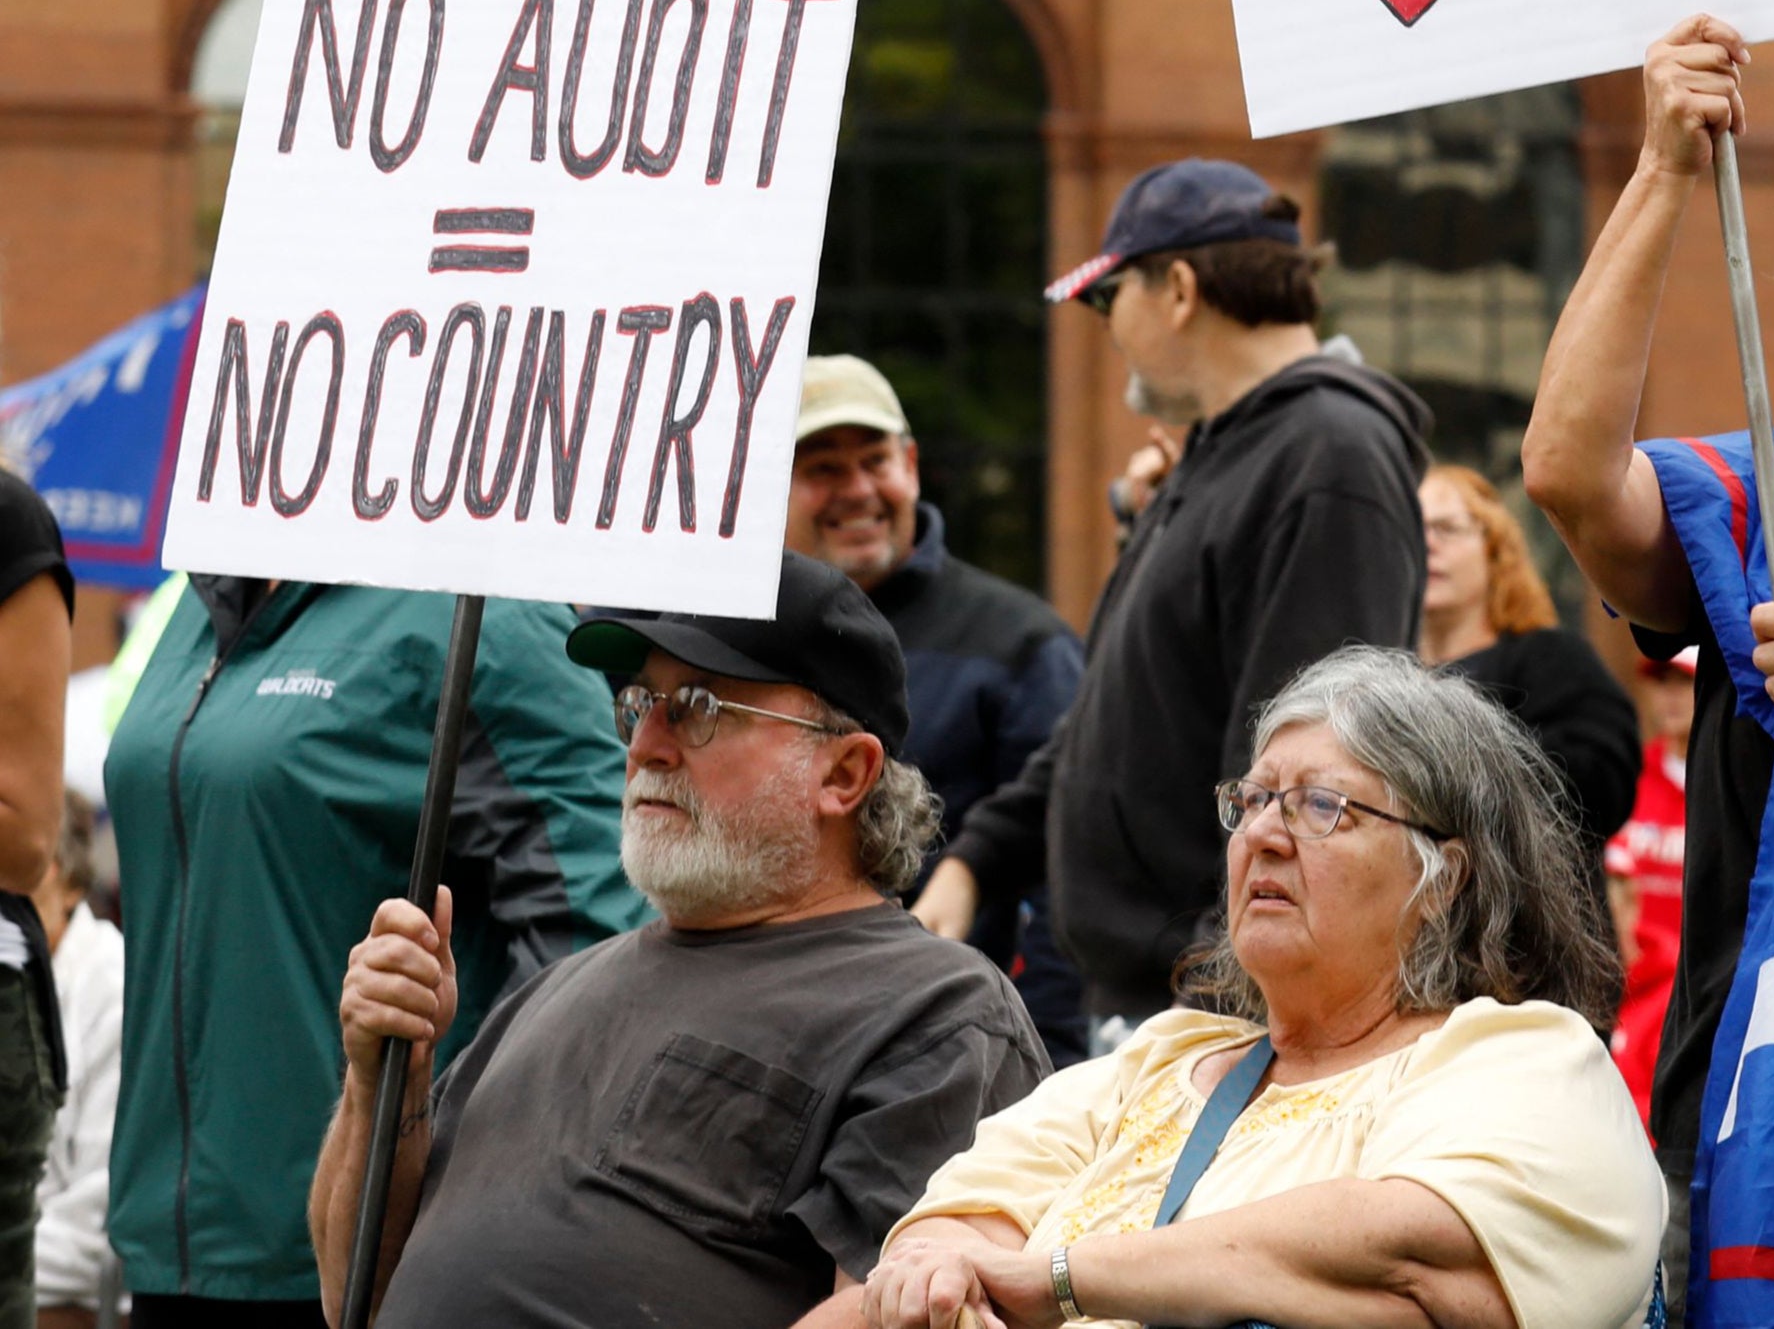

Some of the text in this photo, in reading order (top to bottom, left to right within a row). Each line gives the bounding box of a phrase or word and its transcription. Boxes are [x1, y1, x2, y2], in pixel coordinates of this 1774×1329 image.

[428, 207, 535, 274] =
[198, 310, 345, 519] NO
[351, 291, 796, 539] COUNTRY
[256, 678, 336, 699] WILDCATS
